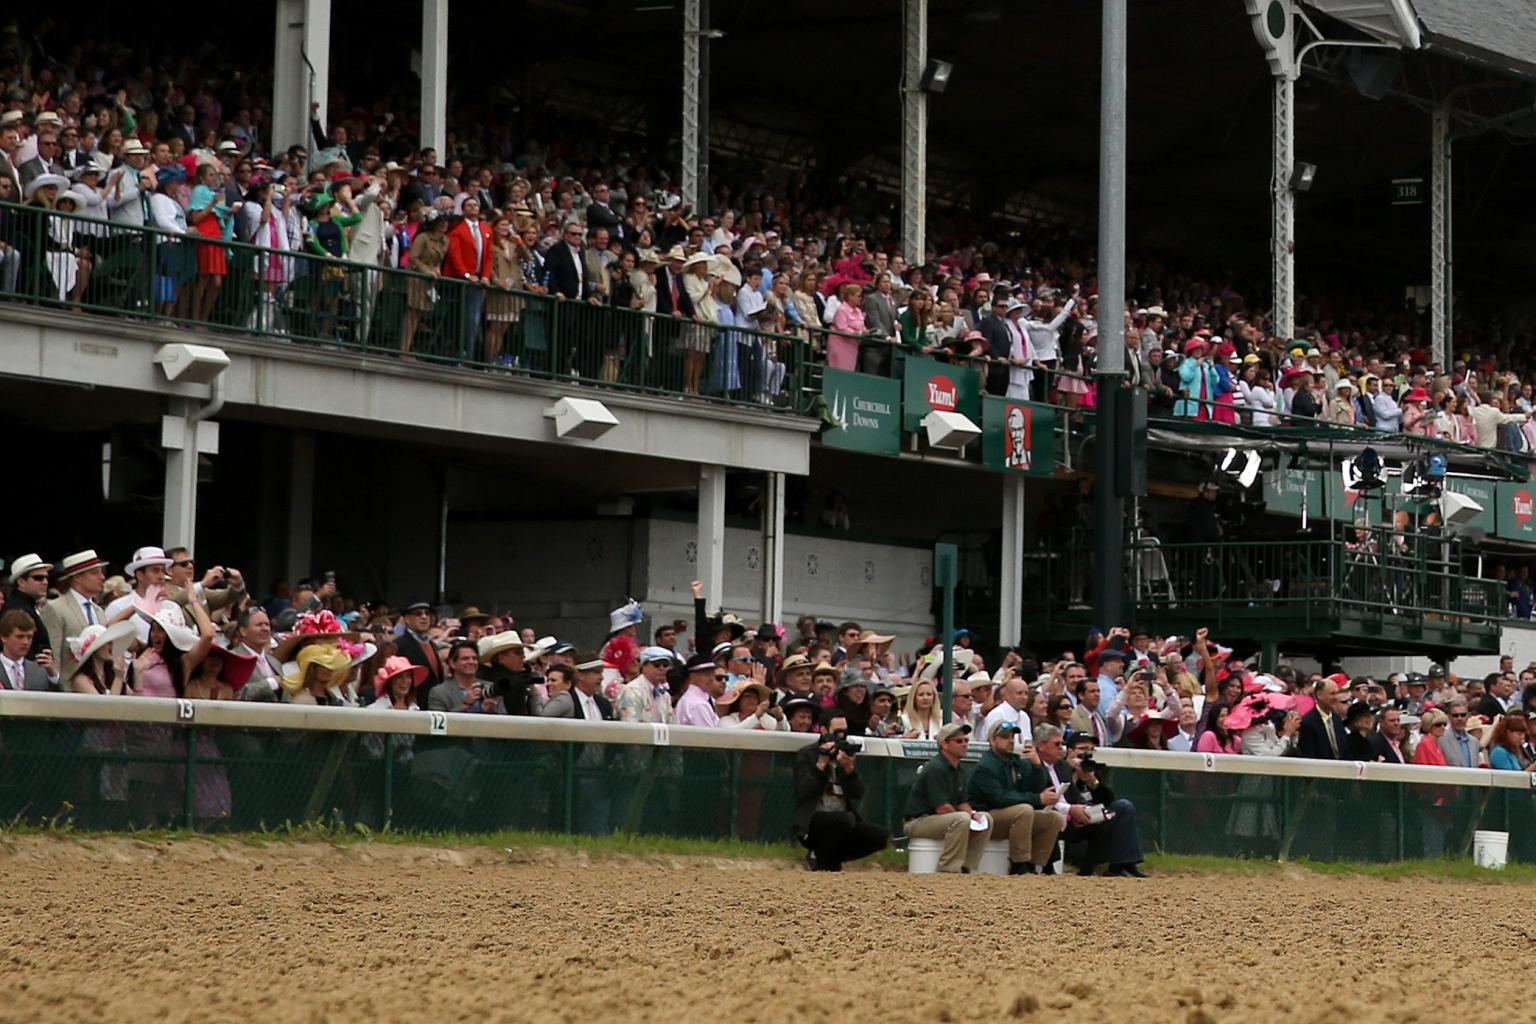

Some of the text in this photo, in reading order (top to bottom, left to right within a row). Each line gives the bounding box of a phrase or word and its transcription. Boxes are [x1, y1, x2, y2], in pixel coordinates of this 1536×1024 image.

[1397, 186, 1417, 198] 318
[928, 382, 956, 408] Yum!
[853, 396, 890, 414] CHURCHILL
[853, 413, 879, 429] DOWNS
[179, 700, 194, 719] 13
[432, 714, 446, 730] 12
